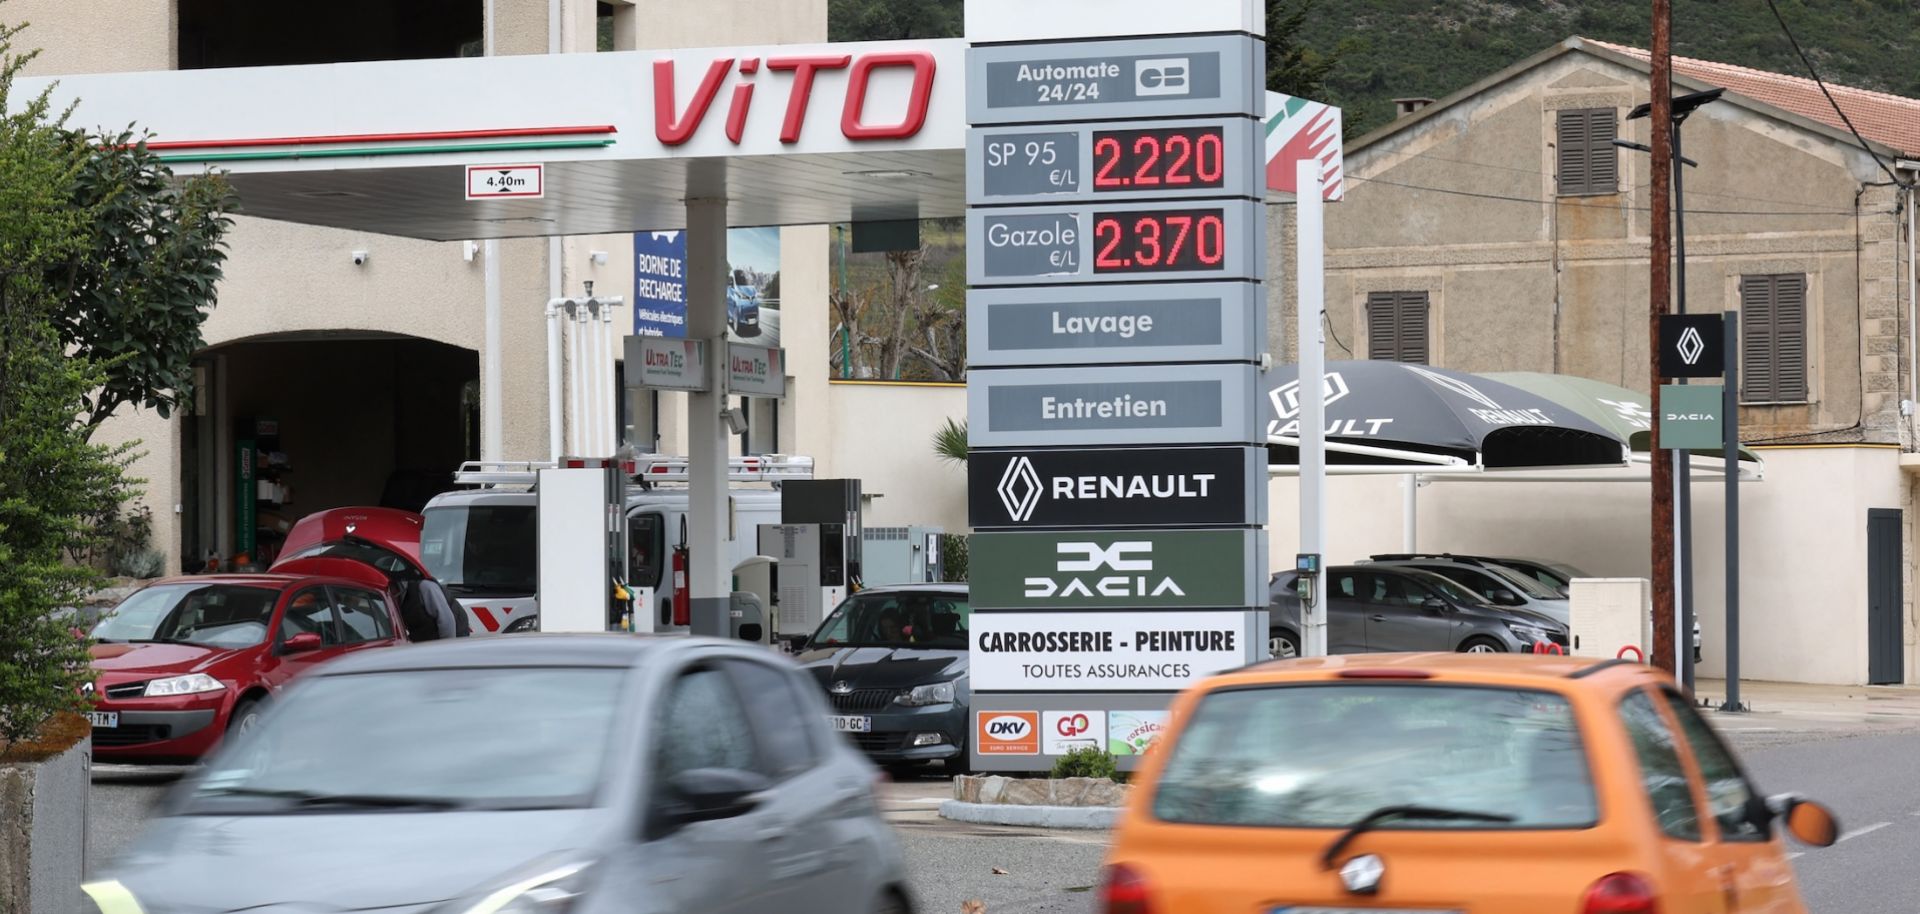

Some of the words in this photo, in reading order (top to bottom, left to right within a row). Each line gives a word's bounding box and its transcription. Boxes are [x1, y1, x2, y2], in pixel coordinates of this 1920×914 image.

[1016, 62, 1120, 82] Automate
[1037, 83, 1100, 103] 24/24
[988, 142, 1016, 166] SP
[1025, 141, 1056, 165] 95
[1095, 133, 1223, 187] 2.220
[487, 176, 526, 187] 4.40m
[1049, 169, 1076, 186] €/L
[988, 222, 1075, 246] Gazole
[1095, 215, 1223, 268] 2.370
[639, 253, 669, 276] BORNE
[670, 258, 682, 278] DE
[1049, 250, 1076, 267] €/L
[639, 278, 683, 302] RECHARGE
[1052, 311, 1153, 338] Lavage
[1041, 394, 1166, 419] Entretien
[1467, 407, 1555, 424] RENAULT
[1666, 413, 1714, 421] DACIA
[1053, 474, 1215, 499] RENAULT
[1024, 576, 1186, 597] DACIA
[979, 631, 1113, 652] CARROSSERIE
[1135, 631, 1235, 652] PEINTURE
[1022, 664, 1082, 678] TOUTES
[1086, 663, 1191, 678] ASSURANCES
[989, 722, 1026, 734] DKV
[1057, 713, 1089, 736] GO
